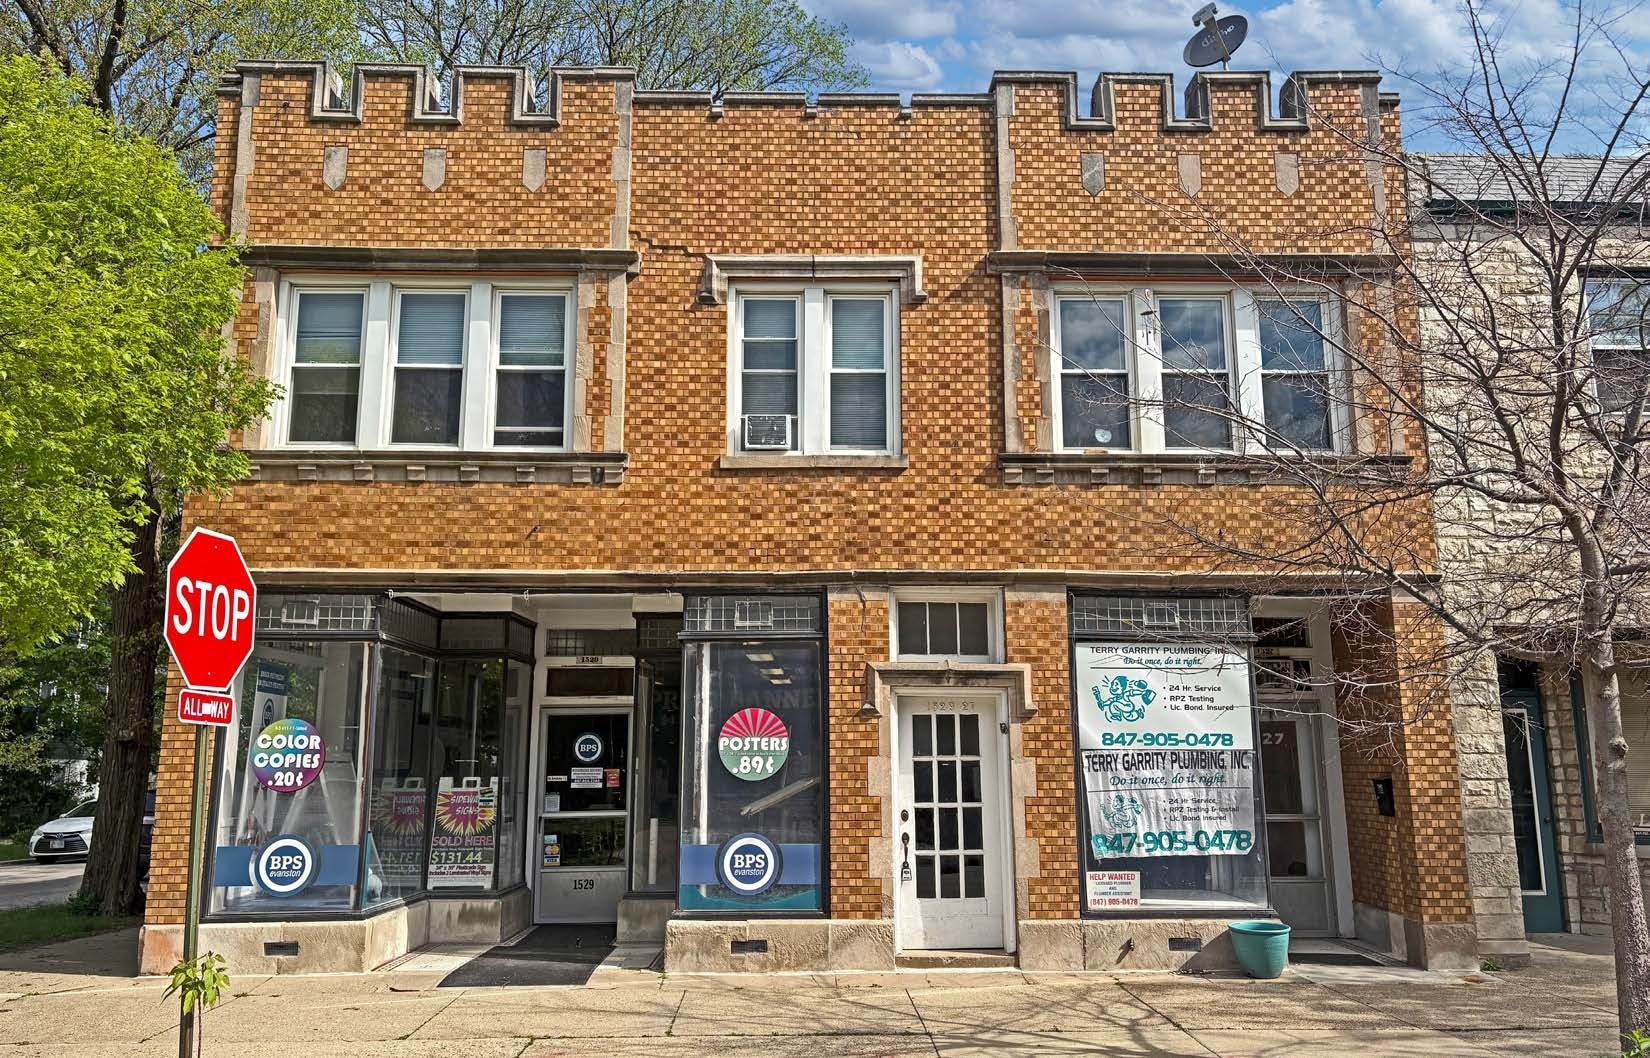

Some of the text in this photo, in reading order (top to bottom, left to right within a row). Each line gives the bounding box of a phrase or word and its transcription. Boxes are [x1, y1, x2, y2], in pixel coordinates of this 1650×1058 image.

[173, 576, 250, 641] STOP
[1090, 646, 1119, 654] TERRY
[1121, 646, 1160, 654] GARRITY
[1123, 657, 1136, 665] Do
[1144, 658, 1162, 666] once,
[1164, 657, 1174, 665] do
[1175, 657, 1182, 665] it
[1188, 695, 1214, 703] Testing
[184, 697, 230, 719] ALL WAY
[257, 734, 320, 750] COLOR
[719, 736, 788, 751] POSTERS
[1101, 732, 1234, 747] 847-905-0478
[1262, 733, 1284, 745] 27
[580, 744, 597, 752] BPS
[254, 752, 320, 769] COPIES
[1085, 753, 1119, 772] TERRY
[1122, 752, 1166, 771] GARRITY
[267, 771, 304, 786] .20¢
[1110, 776, 1126, 785] Do
[1130, 775, 1138, 785] it
[1141, 776, 1167, 786] once,
[1172, 773, 1185, 783] do
[1187, 774, 1196, 784] it
[432, 835, 494, 847] SOLD HERE
[1093, 830, 1252, 855] 847-905-0478
[269, 855, 303, 870] BPS
[431, 851, 482, 864] $131.44
[733, 854, 766, 868] BPS
[270, 869, 301, 878] evanston
[734, 868, 765, 876] evanston
[573, 879, 595, 890] 1529
